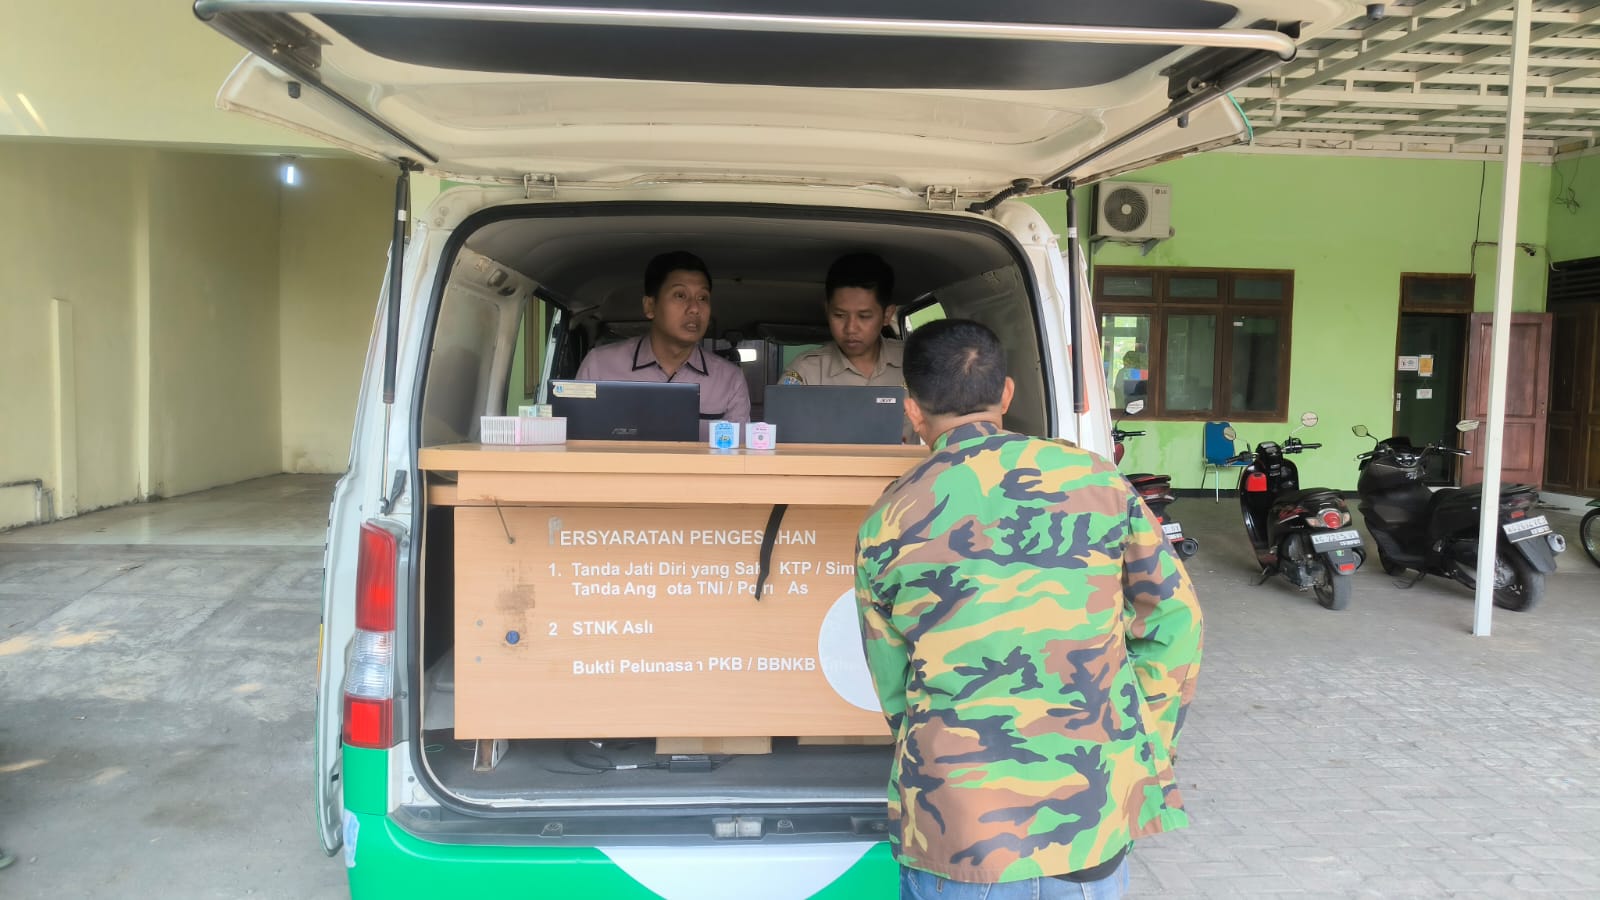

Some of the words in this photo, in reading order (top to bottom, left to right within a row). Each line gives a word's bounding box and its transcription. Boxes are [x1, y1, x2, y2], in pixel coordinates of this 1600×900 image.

[690, 530, 816, 545] PENGESHAN
[548, 562, 562, 577] 1.
[571, 562, 620, 577] Tanda
[624, 561, 653, 576] Jati
[659, 561, 687, 576] Diri
[691, 565, 730, 579] yang
[779, 561, 812, 575] KTP
[815, 561, 821, 575] /
[825, 561, 855, 575] Sim
[571, 582, 620, 596] Tanda
[697, 581, 723, 595] TNI
[727, 581, 733, 595] /
[572, 620, 618, 636] STNK
[572, 660, 615, 675] Bukti
[708, 657, 743, 671] PKB
[746, 657, 752, 671] /
[757, 657, 816, 672] BBNKB
